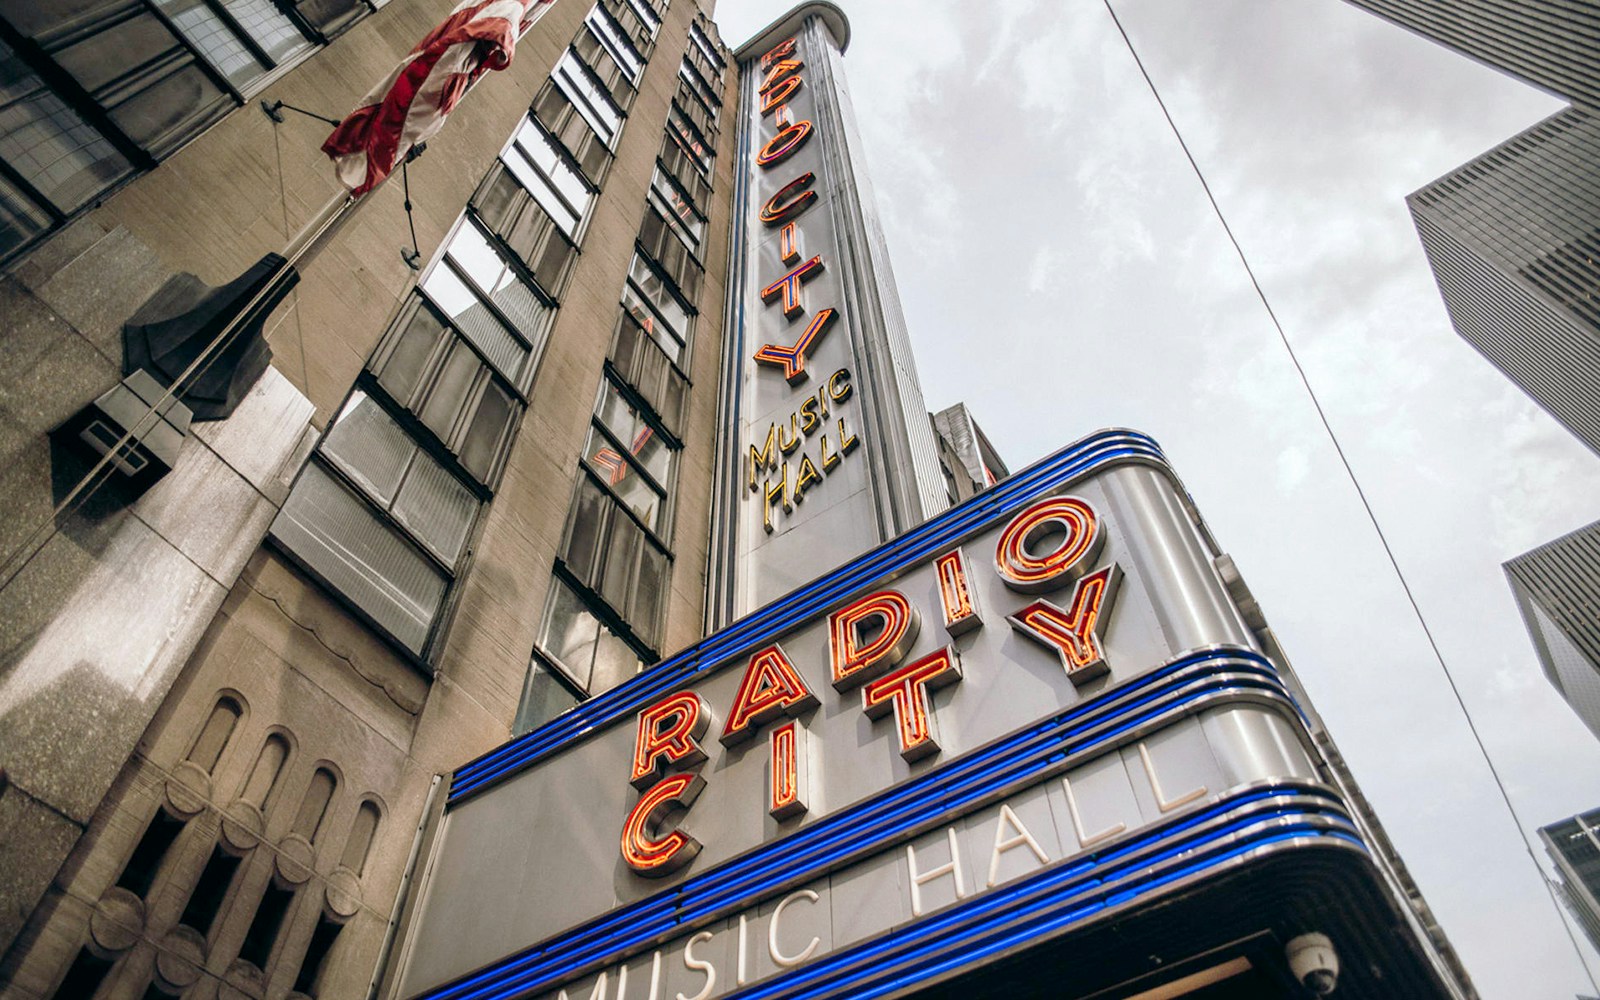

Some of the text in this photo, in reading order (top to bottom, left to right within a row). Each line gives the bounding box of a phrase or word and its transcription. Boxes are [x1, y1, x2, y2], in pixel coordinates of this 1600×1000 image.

[753, 37, 840, 388] RADIO CITY
[749, 367, 854, 493] MUSIC
[763, 416, 861, 535] HALL
[620, 562, 1124, 878] CITY
[629, 494, 1107, 789] RADIO
[557, 741, 1209, 1000] USIC HALL
